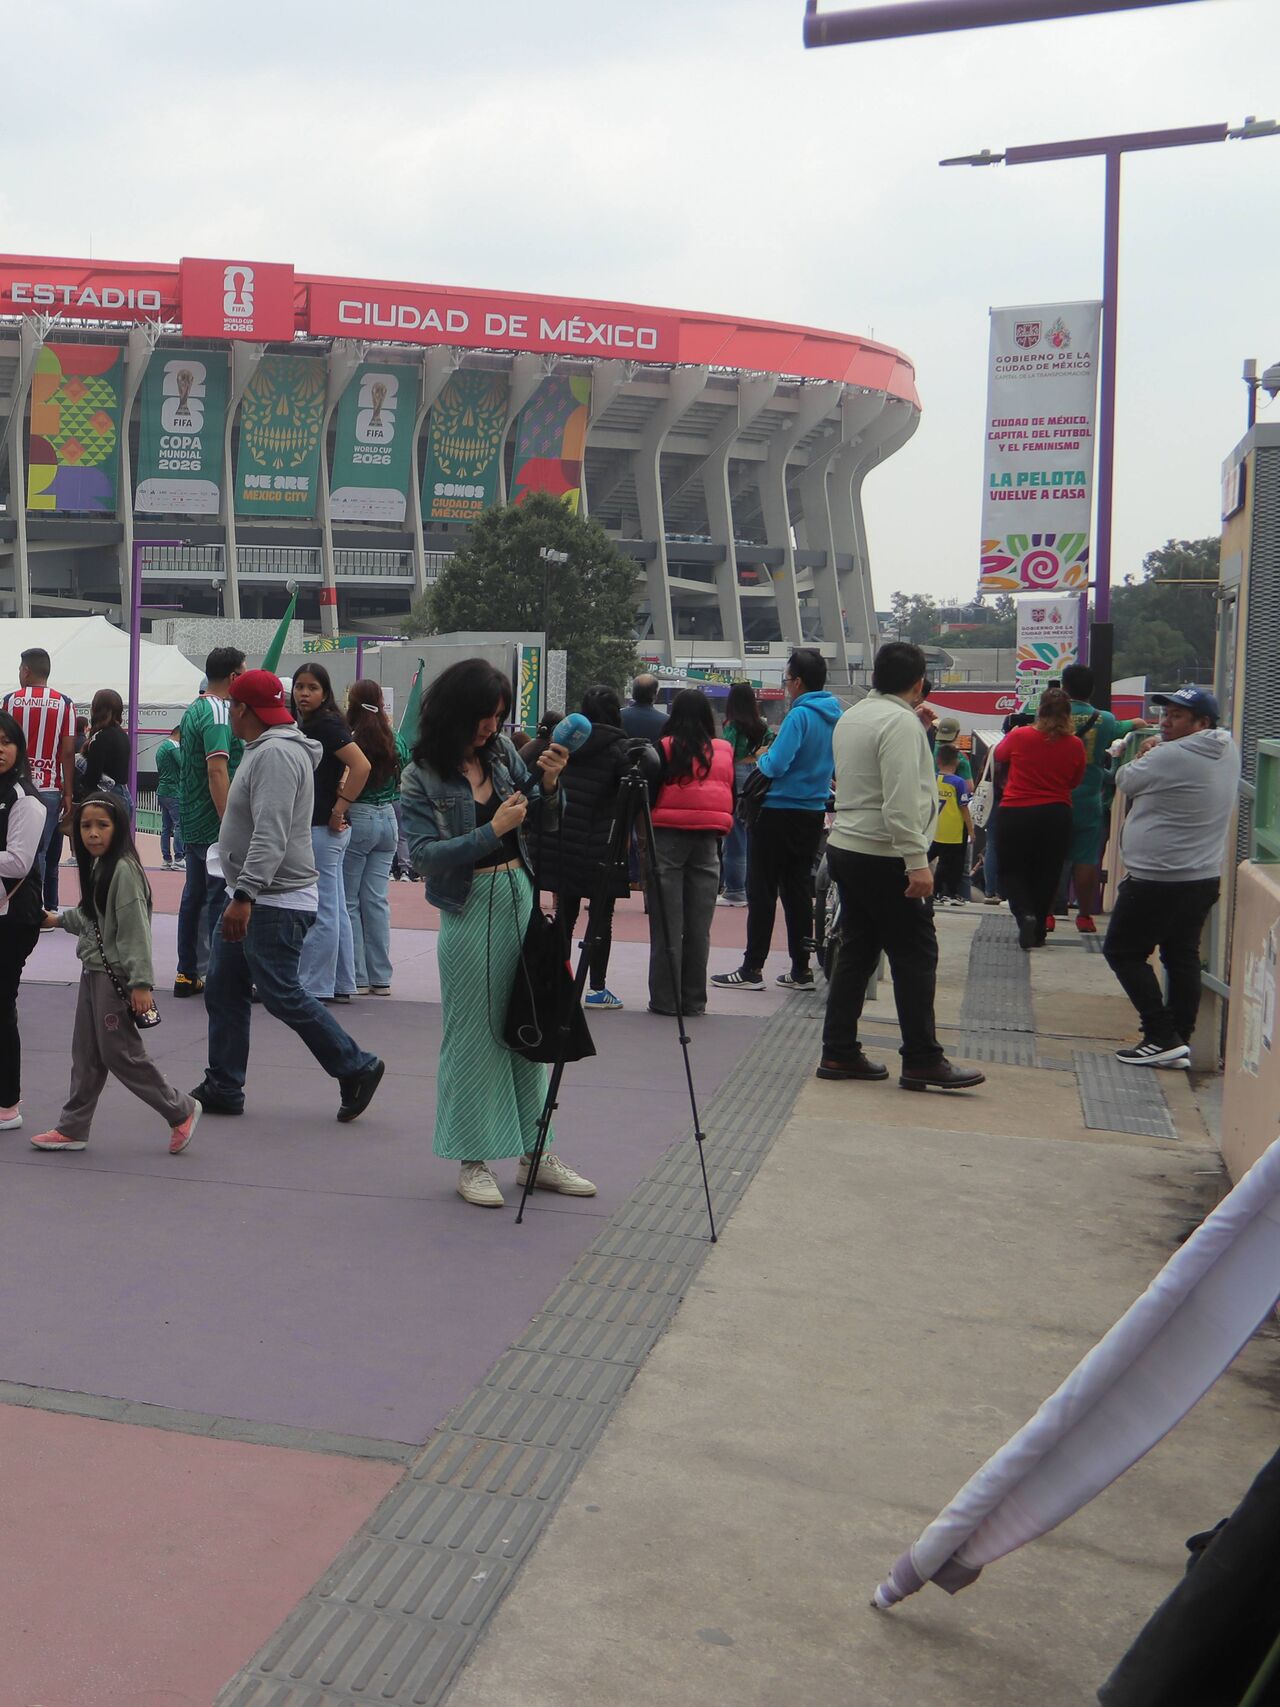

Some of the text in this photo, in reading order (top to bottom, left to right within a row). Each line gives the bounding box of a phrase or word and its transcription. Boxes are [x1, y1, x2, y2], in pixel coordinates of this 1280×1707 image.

[11, 282, 161, 310] ESTADIO
[231, 305, 246, 313] FIFA
[223, 324, 254, 332] 2026
[338, 300, 657, 350] CIUDAD DE MÉXICO
[996, 354, 1054, 363] GOBIERNO
[1058, 352, 1073, 360] DE
[995, 364, 1033, 372] CIUDAD
[1052, 361, 1091, 369] MÉXICO
[173, 418, 192, 427] FIFA
[992, 418, 1029, 427] CIUDAD
[1031, 417, 1045, 426] DE
[366, 430, 384, 438] FIFA
[988, 428, 1092, 440] CAPITAL DEL FUTBOL
[160, 436, 202, 450] COPA
[999, 442, 1080, 452] Y EL FEMINISMO
[159, 450, 202, 459] MUNDIAL
[354, 445, 392, 454] WORLD CUP
[352, 453, 392, 465] 2026
[158, 459, 202, 471] 2026
[244, 474, 272, 489] WE
[990, 471, 1087, 487] LA PELOTA
[243, 490, 308, 502] MEXICO CITY
[433, 483, 485, 499] SOMOS
[990, 488, 1086, 501] VUELVE A CASA
[432, 498, 484, 509] CIUDAD DE
[659, 665, 688, 678] 2026
[13, 697, 59, 708] OMNILIFE
